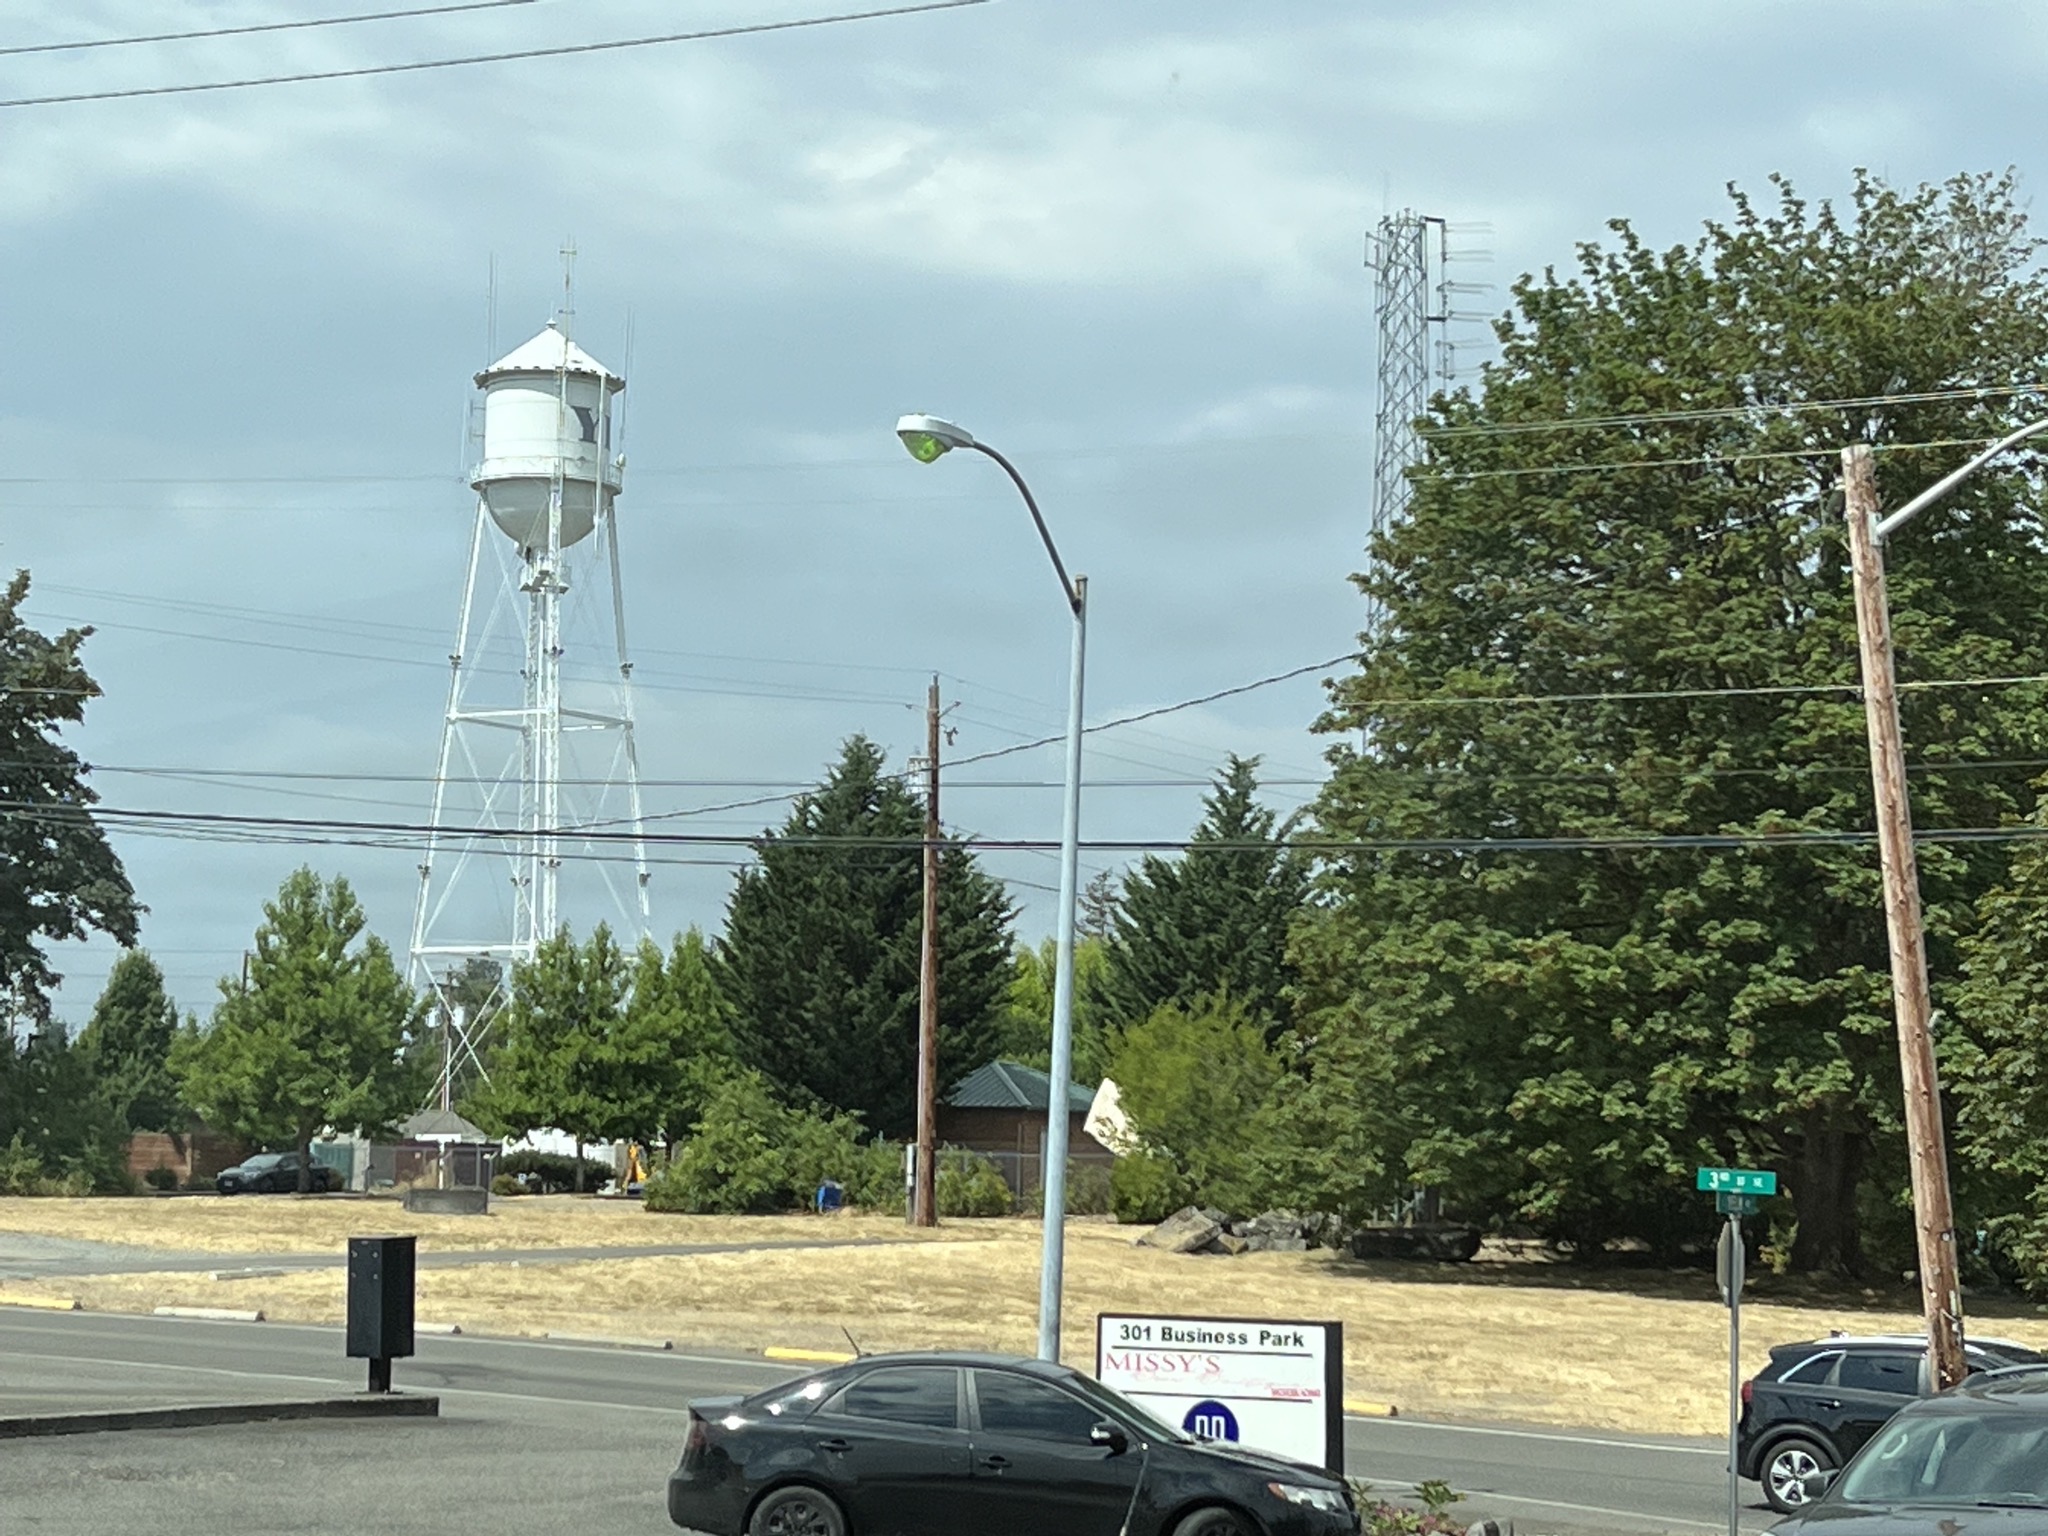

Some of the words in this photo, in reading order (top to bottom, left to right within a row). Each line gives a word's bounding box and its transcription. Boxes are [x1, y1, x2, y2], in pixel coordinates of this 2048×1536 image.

[1120, 1324, 1151, 1341] 301
[1161, 1326, 1248, 1345] Business
[1259, 1330, 1304, 1347] Park
[1105, 1352, 1221, 1374] MISSY'S
